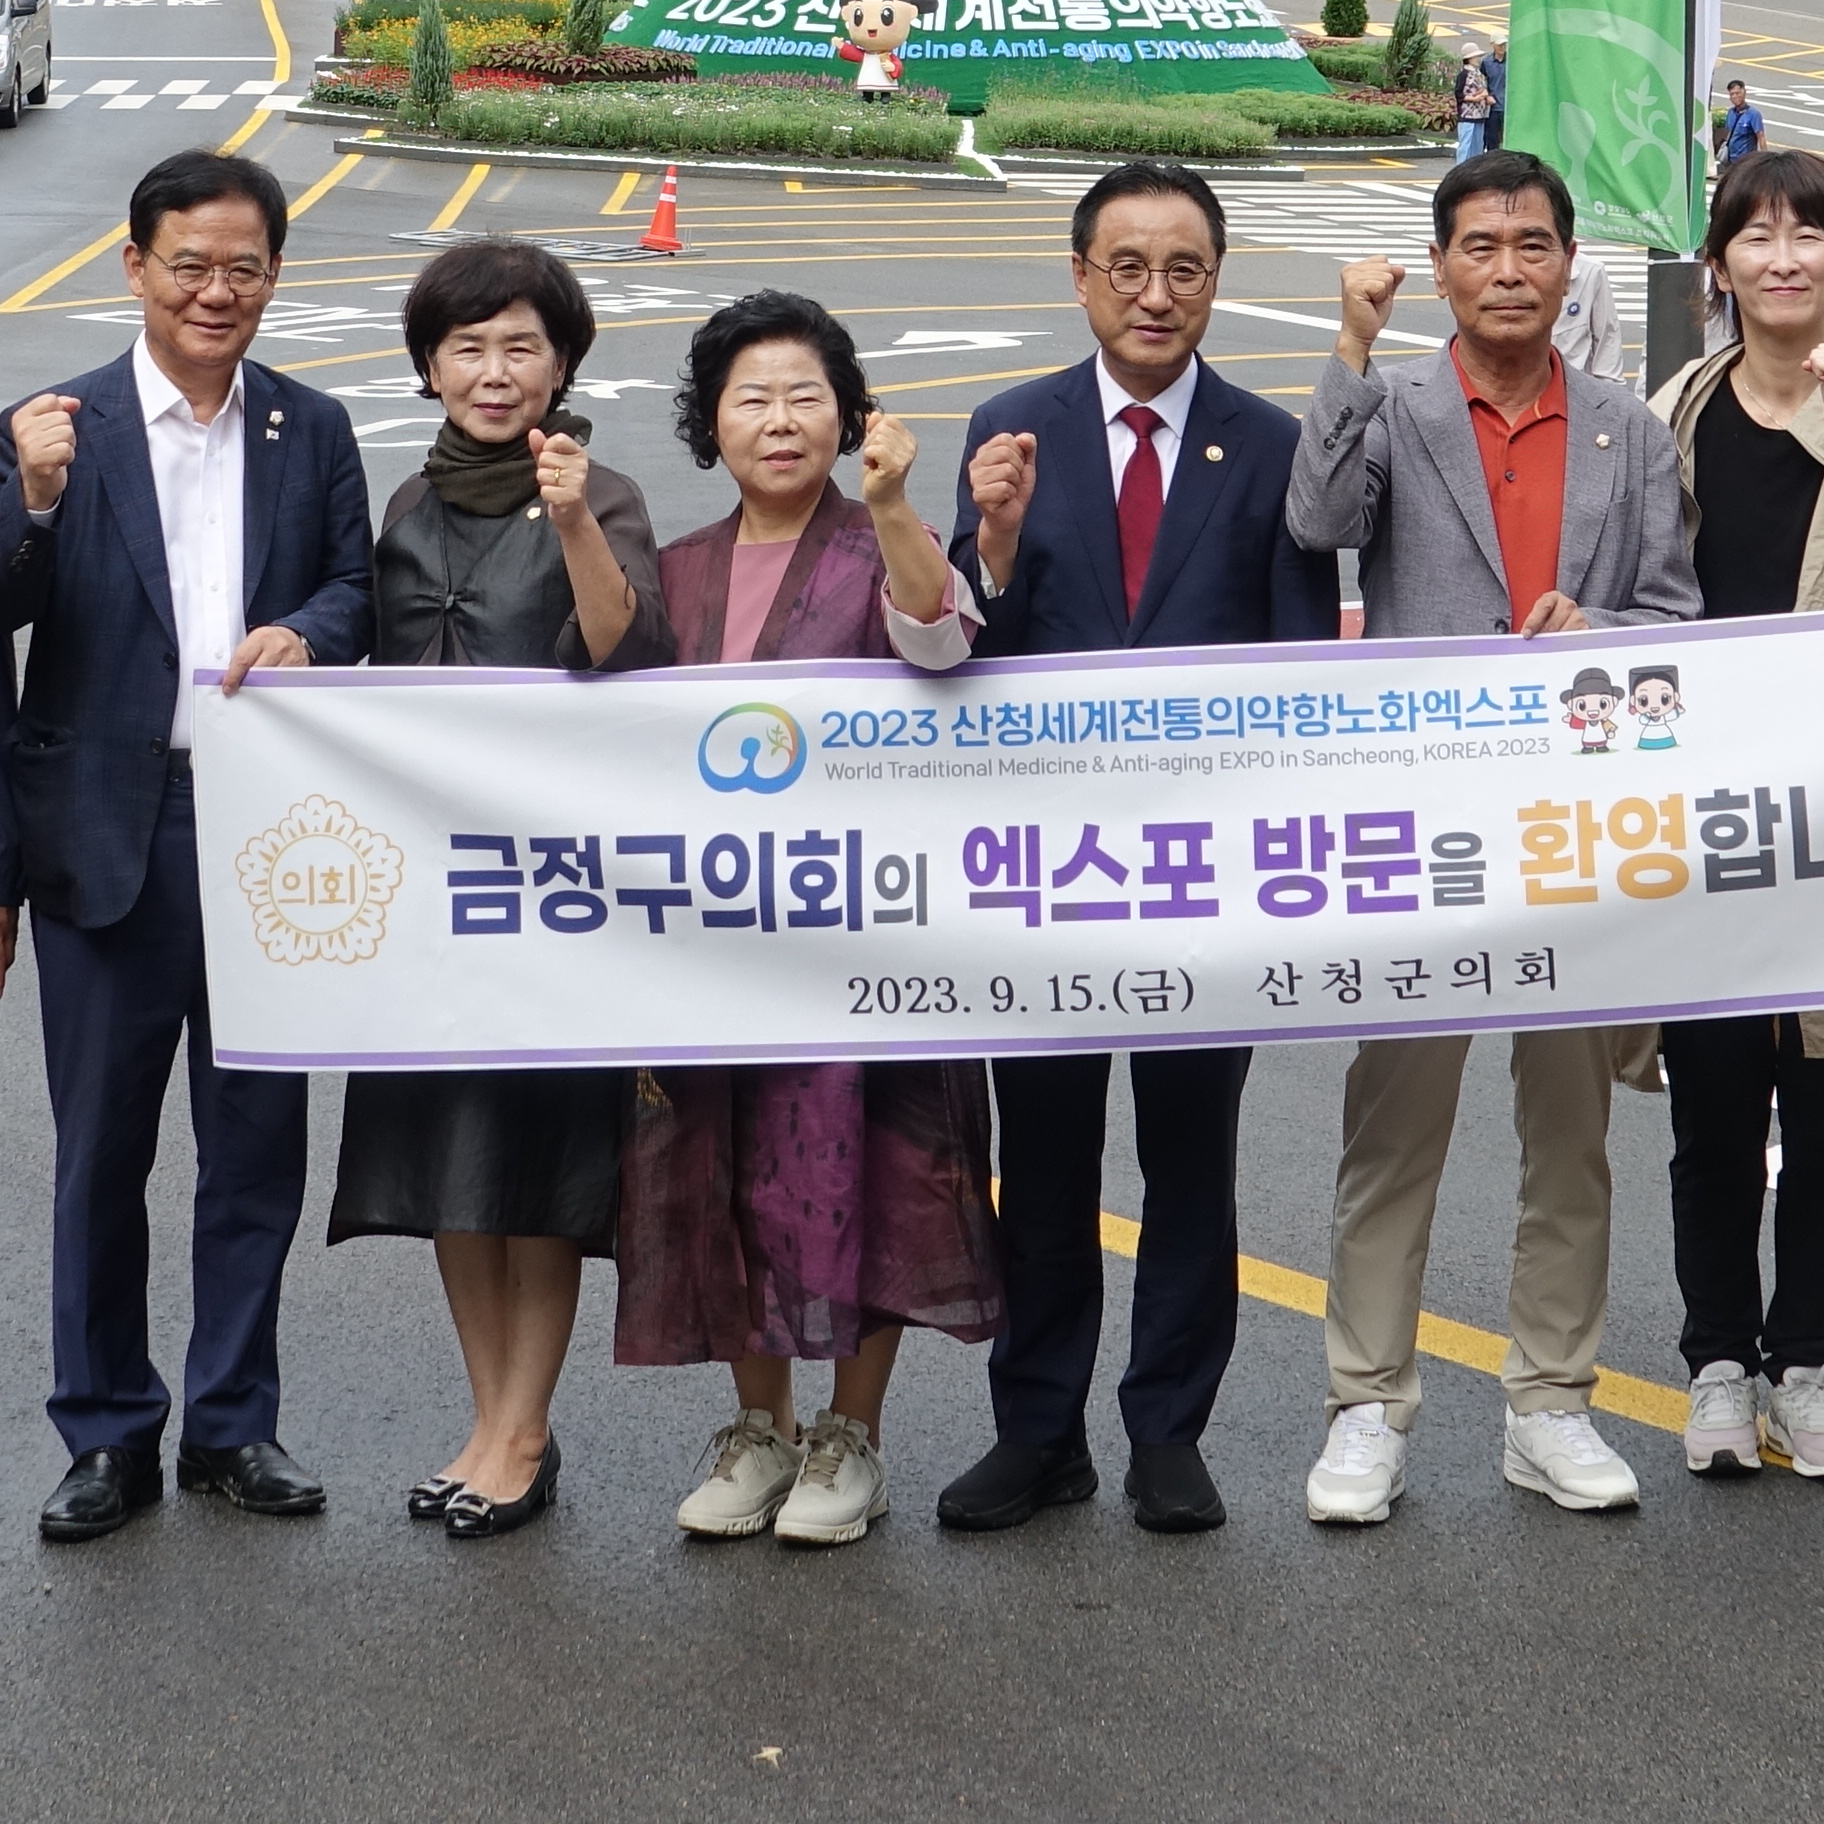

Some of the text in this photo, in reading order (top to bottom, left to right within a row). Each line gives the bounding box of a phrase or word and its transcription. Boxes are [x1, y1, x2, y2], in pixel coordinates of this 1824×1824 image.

[653, 29, 709, 54] World
[710, 34, 836, 59] Traditional
[969, 39, 988, 58] &
[1134, 40, 1198, 60] EXPO
[1196, 40, 1221, 60] in
[821, 684, 1549, 749] 2023 산청세계전통의약항노화엑스포
[825, 737, 1551, 781] World Traditional Medicine & Anti-aging EXPO in Sancheong, KOREA 2023
[278, 865, 357, 907] 의회
[447, 828, 928, 936] 금정구의회의
[962, 821, 1219, 928] 엑스포
[1253, 810, 1487, 918] 방문을
[848, 975, 972, 1015] 2023.
[991, 976, 1029, 1014] 9.
